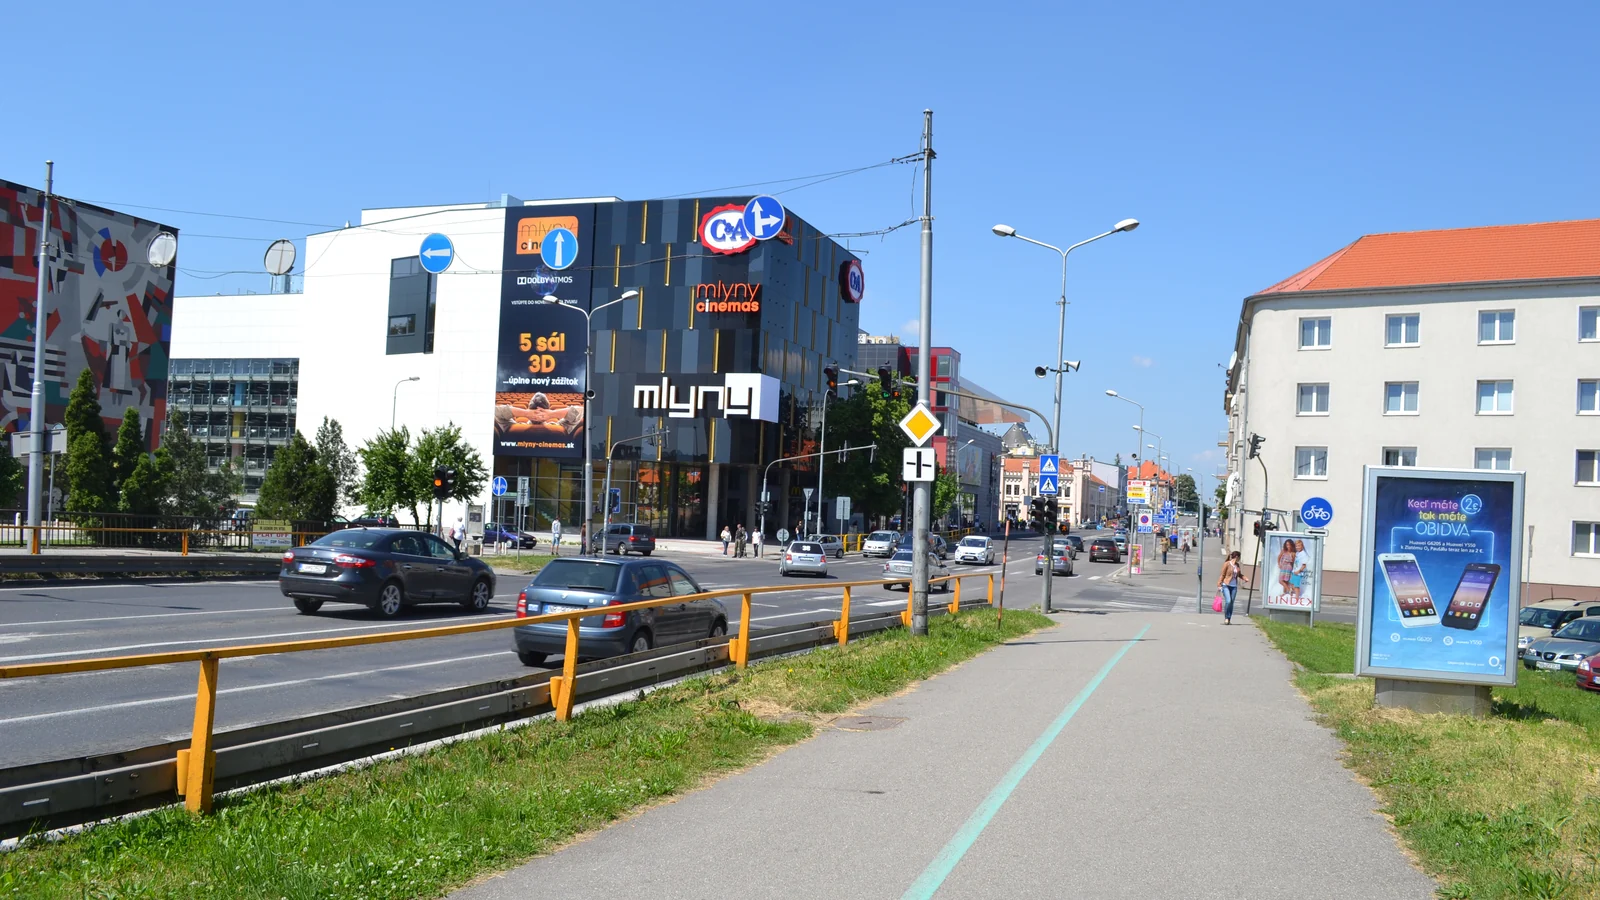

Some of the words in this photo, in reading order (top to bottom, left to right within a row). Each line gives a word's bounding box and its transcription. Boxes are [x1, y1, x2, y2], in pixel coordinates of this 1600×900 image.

[710, 218, 750, 242] C&A
[696, 280, 760, 301] mlyny
[696, 299, 760, 312] cinemas
[520, 332, 532, 352] 5
[536, 332, 565, 352] sál
[528, 354, 556, 373] 3D
[531, 376, 550, 386] nový
[551, 376, 578, 386] zážitok
[634, 373, 762, 420] mlyny
[1430, 500, 1459, 510] máte
[1465, 497, 1478, 510] 2€
[1419, 510, 1436, 520] tak
[1439, 511, 1467, 521] máte
[1415, 521, 1470, 537] OBIDVA
